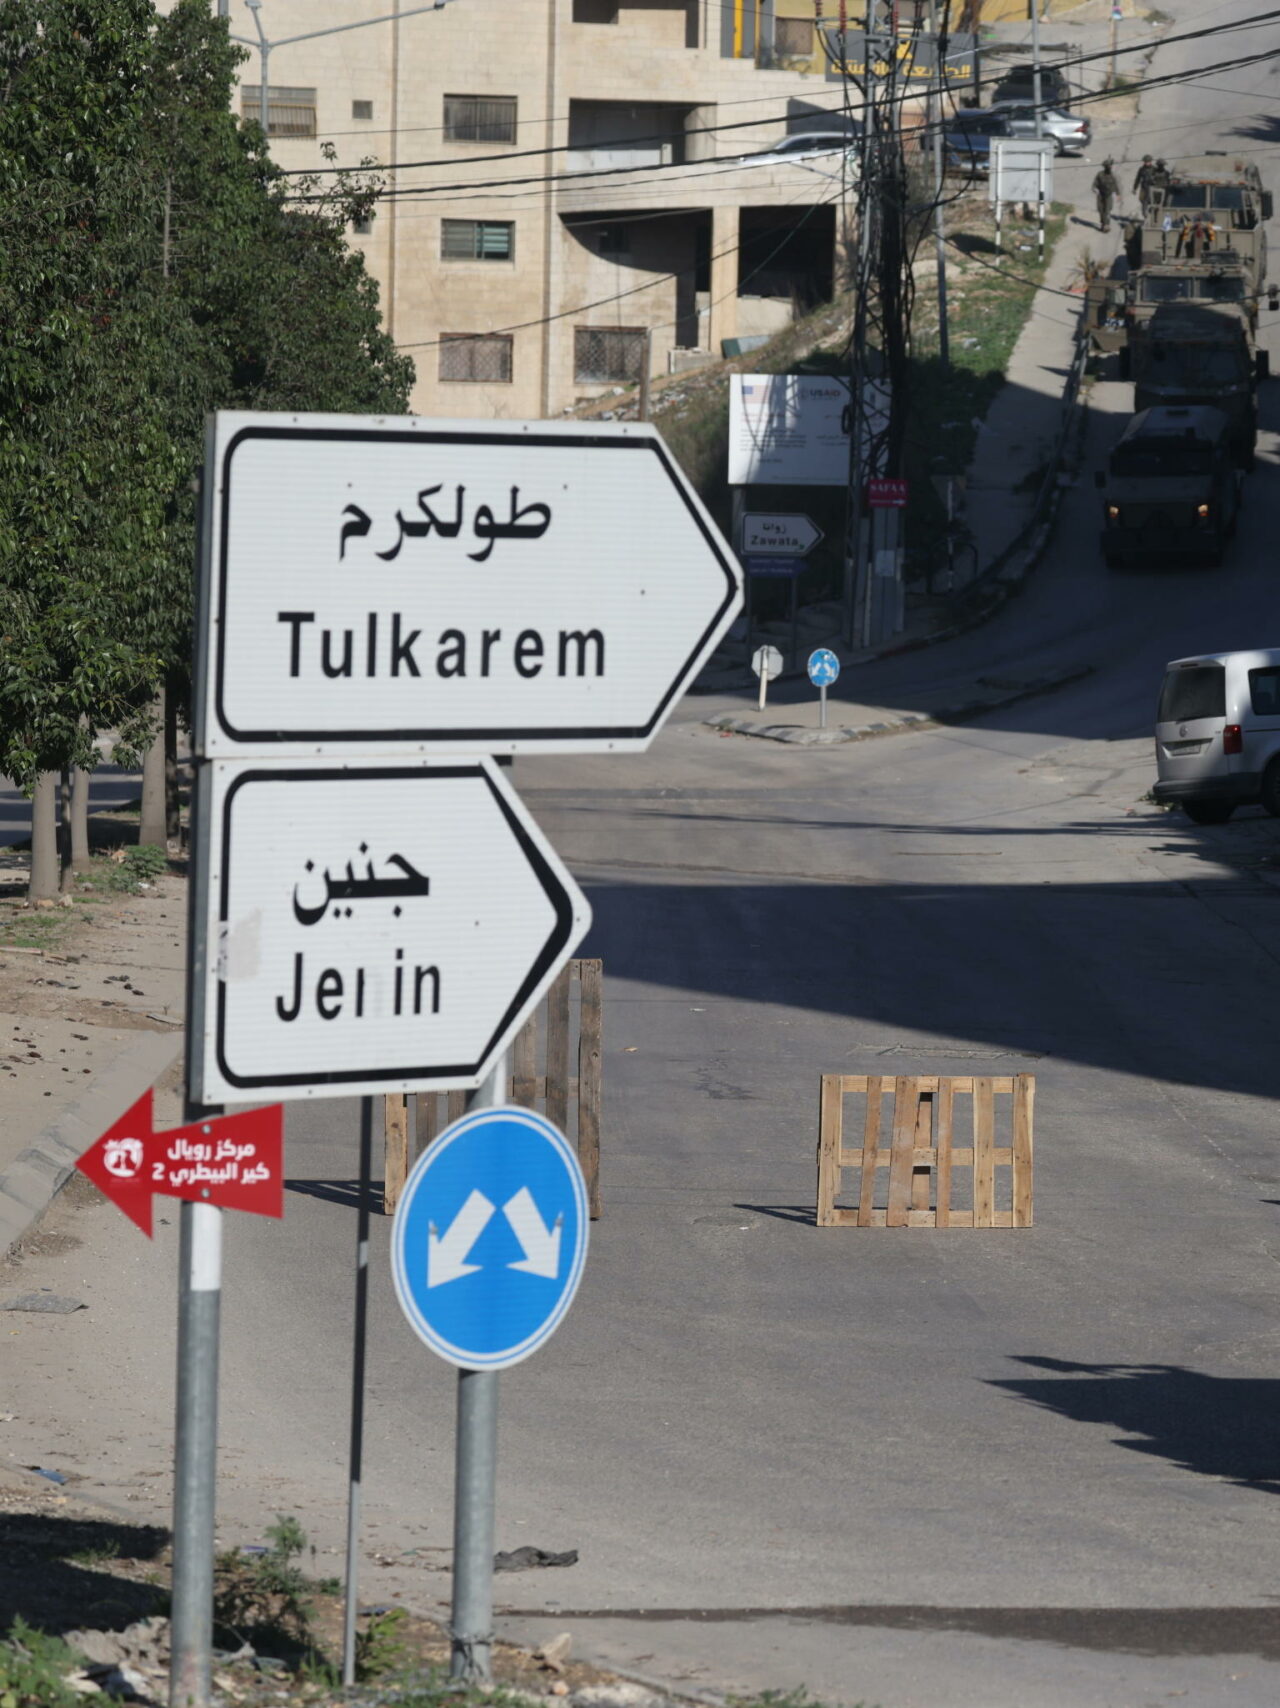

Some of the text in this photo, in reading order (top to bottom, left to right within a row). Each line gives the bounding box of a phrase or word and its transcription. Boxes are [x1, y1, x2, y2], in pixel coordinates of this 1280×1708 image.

[810, 388, 841, 397] USAID
[339, 484, 552, 562] طولكرم
[751, 535, 798, 545] Zawata
[277, 612, 605, 678] Tulkarem
[293, 841, 429, 926] جنين
[167, 1138, 256, 1162] مركز رويال
[152, 1162, 270, 1187] كير البيطري 2
